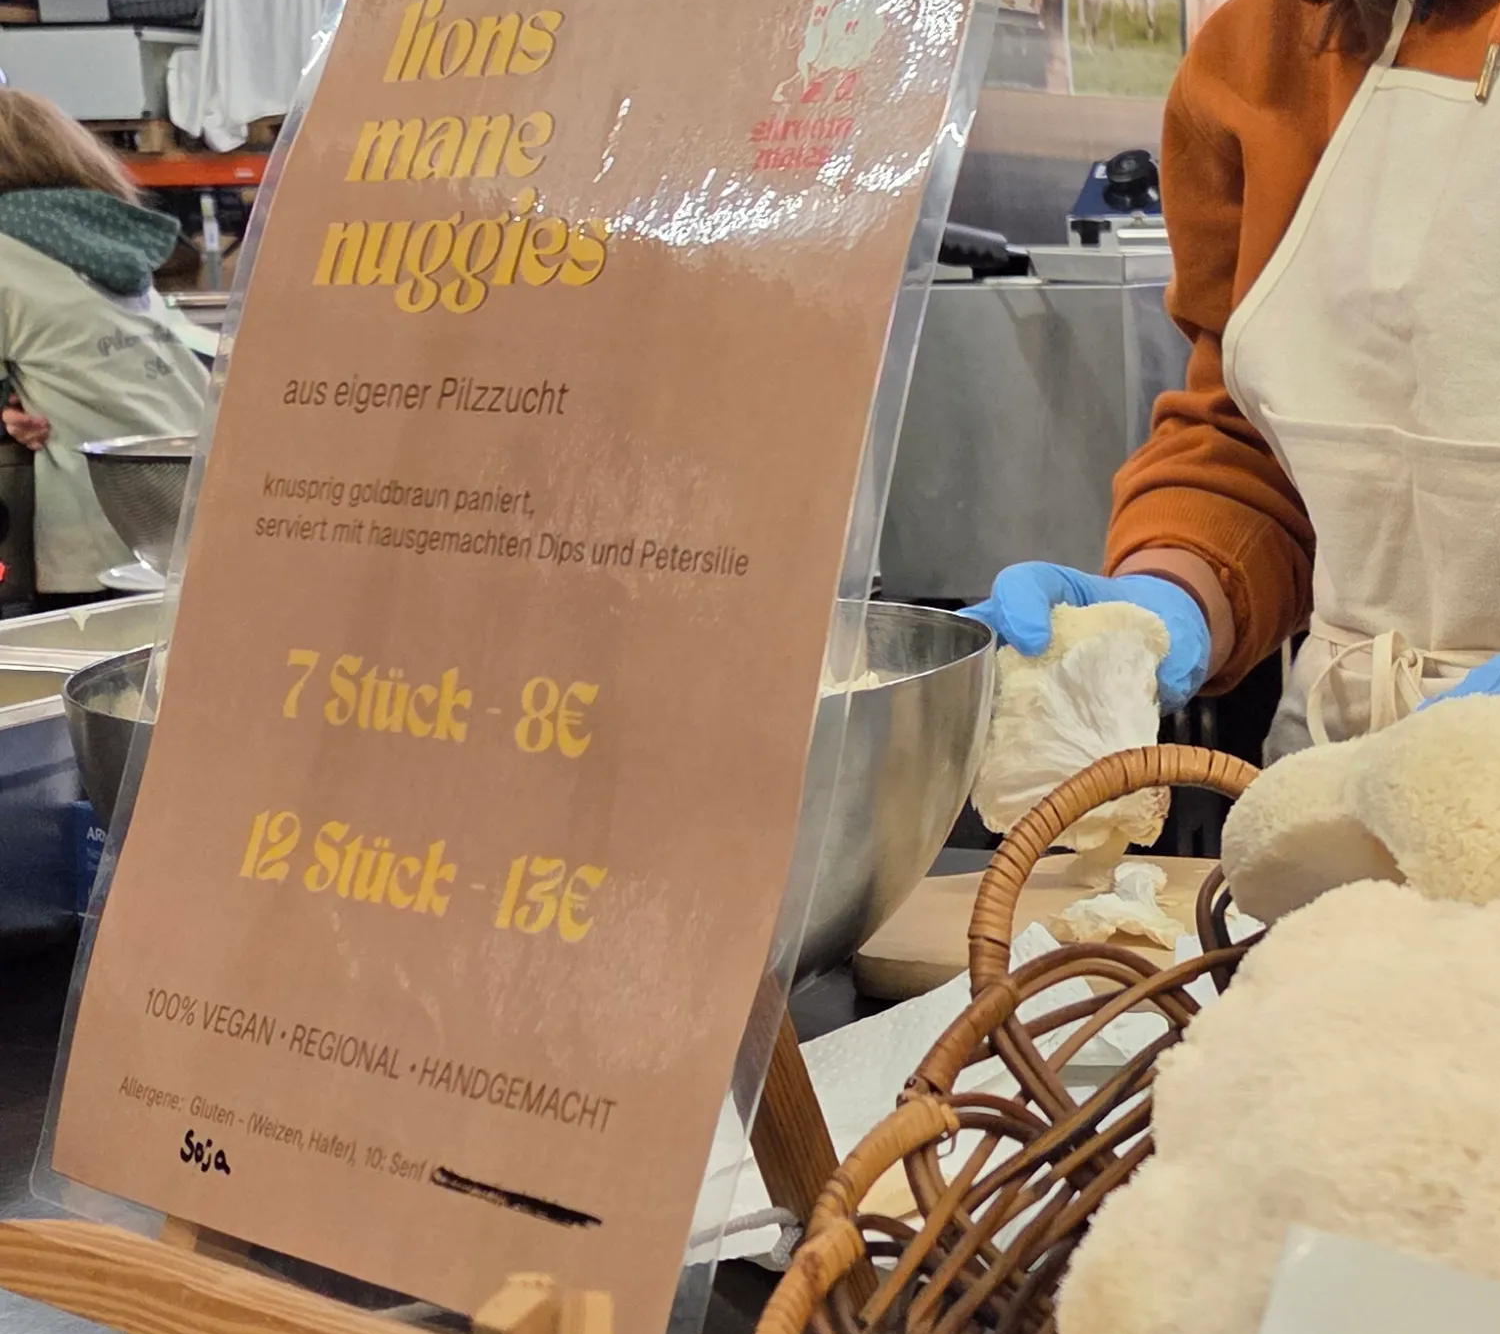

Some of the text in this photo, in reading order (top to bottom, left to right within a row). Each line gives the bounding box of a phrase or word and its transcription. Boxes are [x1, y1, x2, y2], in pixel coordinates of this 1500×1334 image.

[344, 111, 556, 182] mane
[311, 186, 609, 313] nuggies
[283, 376, 570, 415] aus eigener Pilzzucht
[263, 473, 536, 519] knusprig goldbraun paniert,
[254, 514, 751, 578] serviert mit hausgemachten Dips und Petersilie
[282, 647, 321, 720] 7
[323, 652, 475, 744] Stück
[514, 675, 600, 759] 8€
[239, 809, 302, 884] 12
[303, 819, 459, 918] Stück
[493, 854, 609, 944] 13€
[144, 987, 619, 1134] 100% VEGAN REGIONAL HANDGEMACHT
[118, 1076, 184, 1114] Allergene:
[189, 1094, 237, 1129] Gluten
[180, 1129, 231, 1176] Soja
